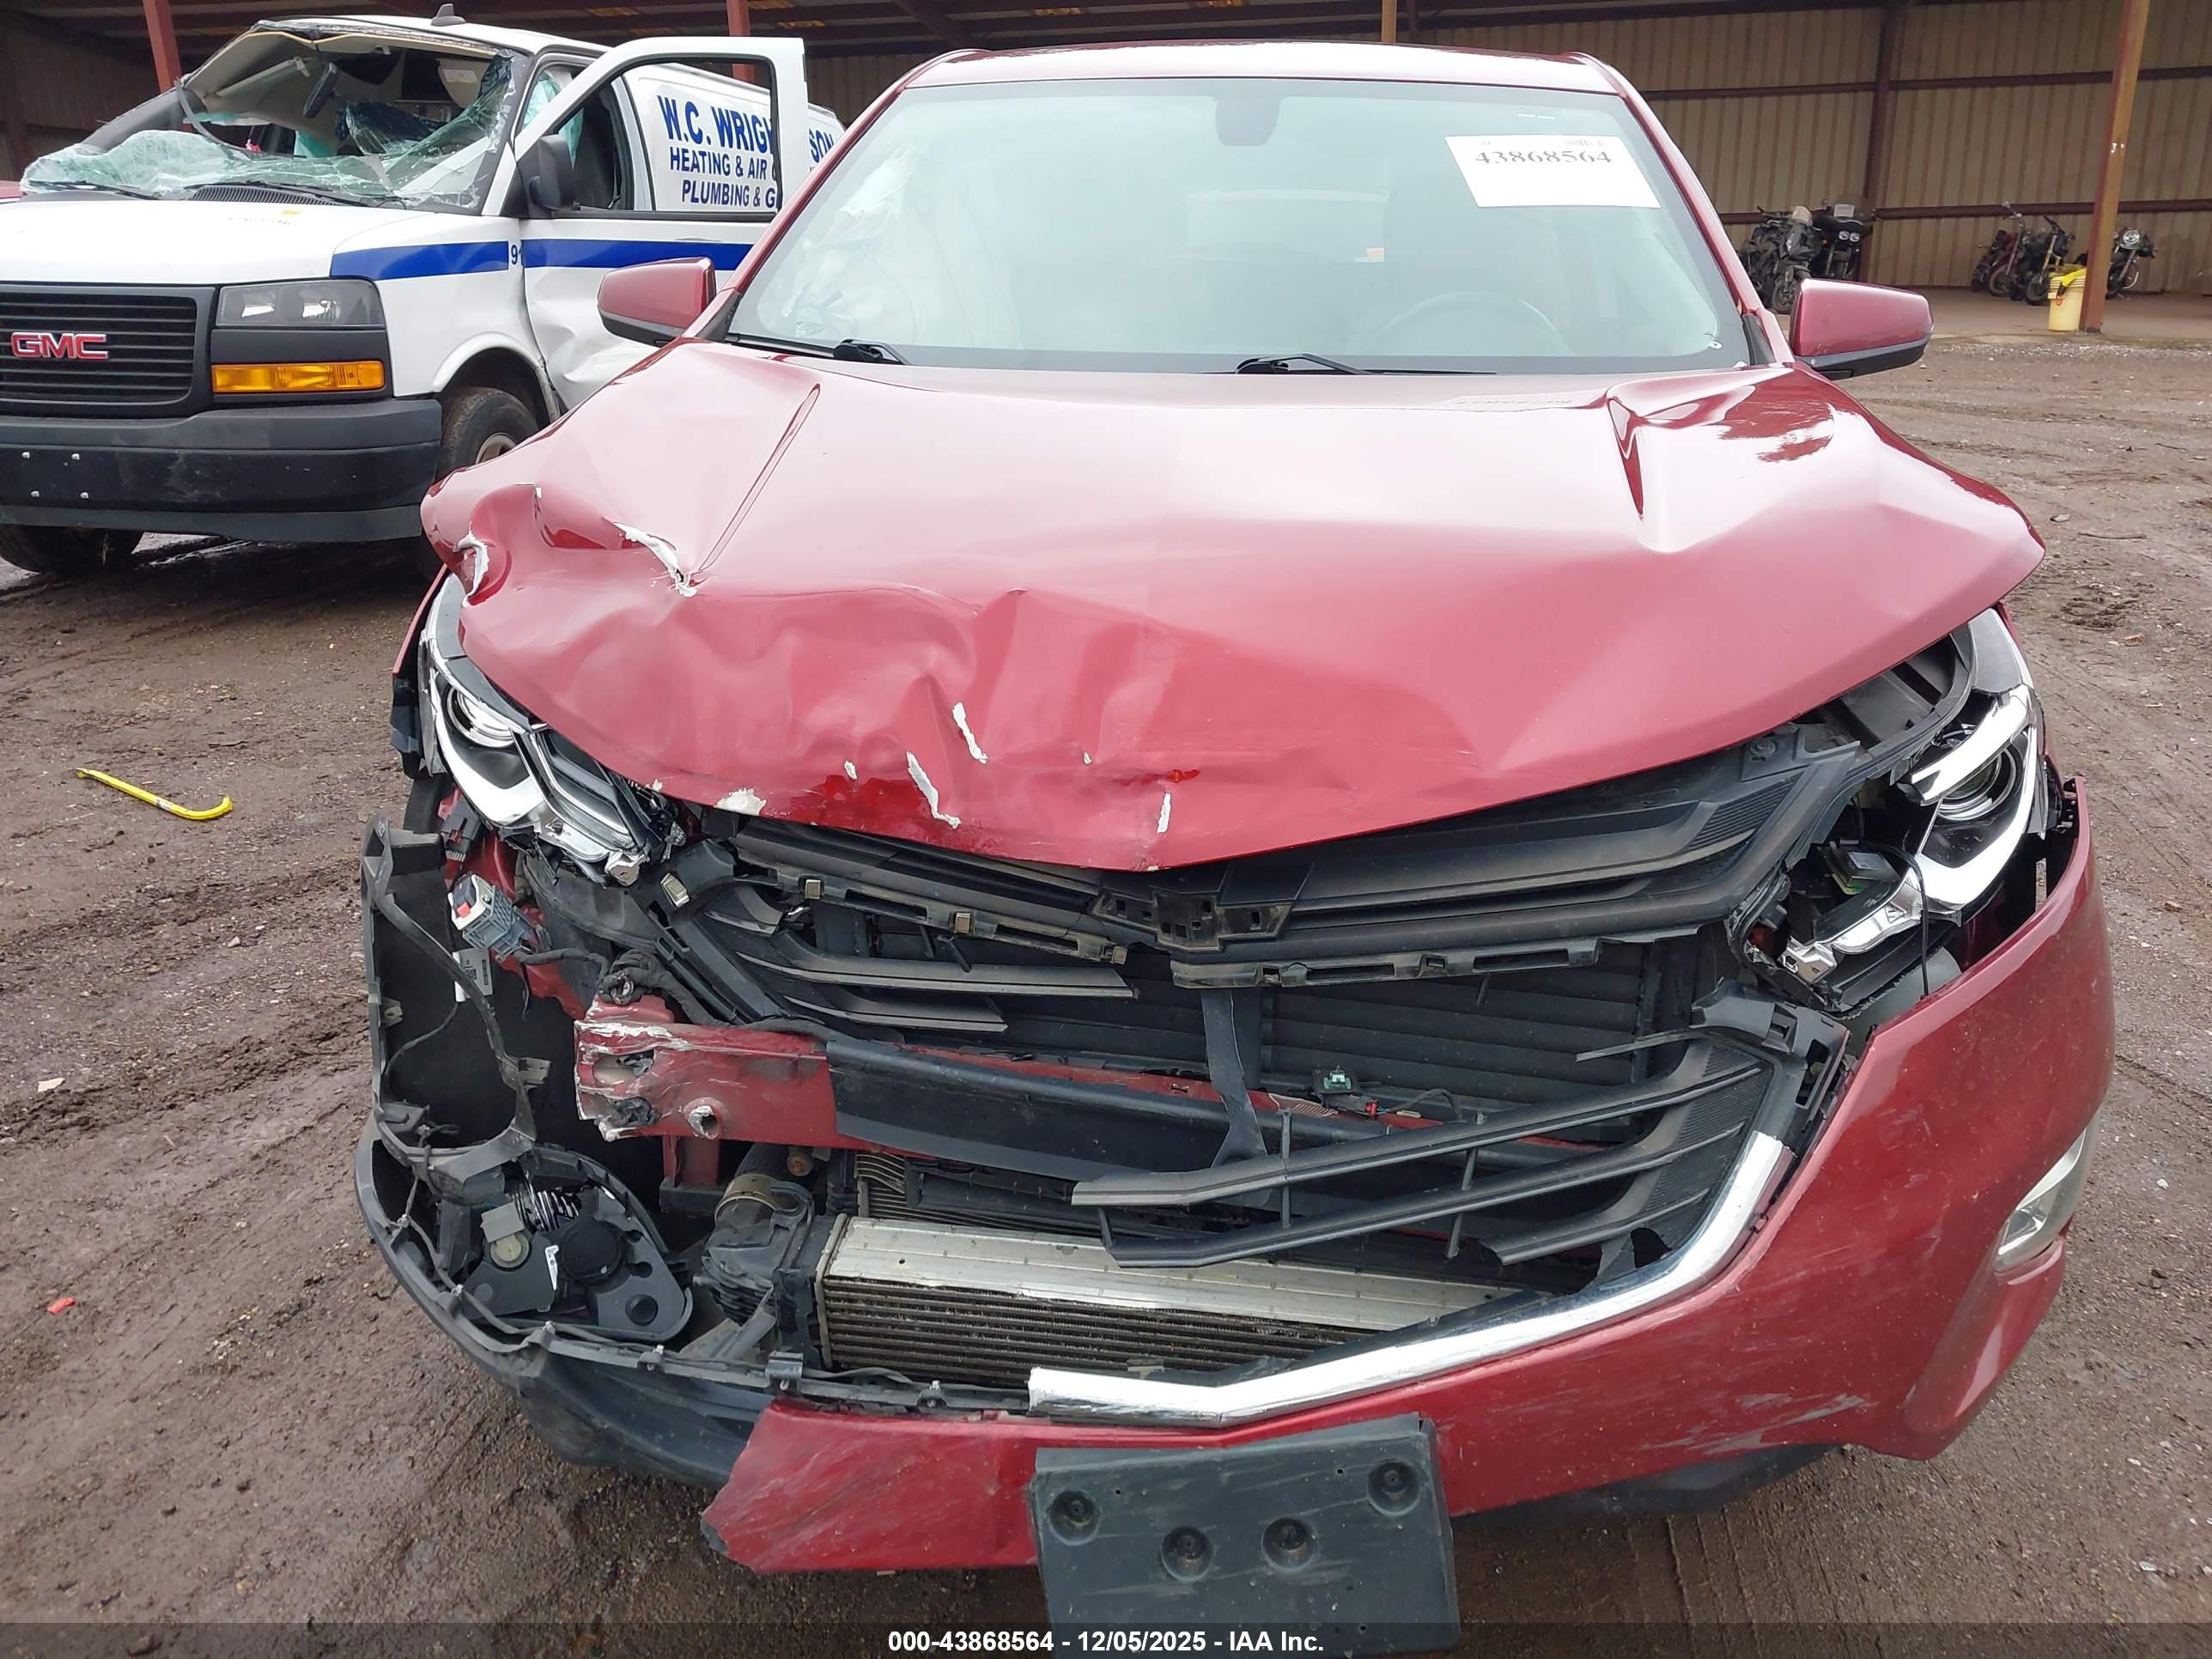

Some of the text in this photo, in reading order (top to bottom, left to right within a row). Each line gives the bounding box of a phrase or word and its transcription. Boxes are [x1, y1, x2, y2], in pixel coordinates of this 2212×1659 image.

[657, 95, 712, 145] W.C.
[670, 147, 731, 177] HEATING
[735, 155, 744, 177] &
[748, 158, 767, 180] AIR
[1474, 150, 1613, 164] 43868564
[682, 179, 750, 207] PLUMBING
[753, 186, 760, 207] &
[511, 244, 522, 265] 9
[11, 332, 108, 359] GMC
